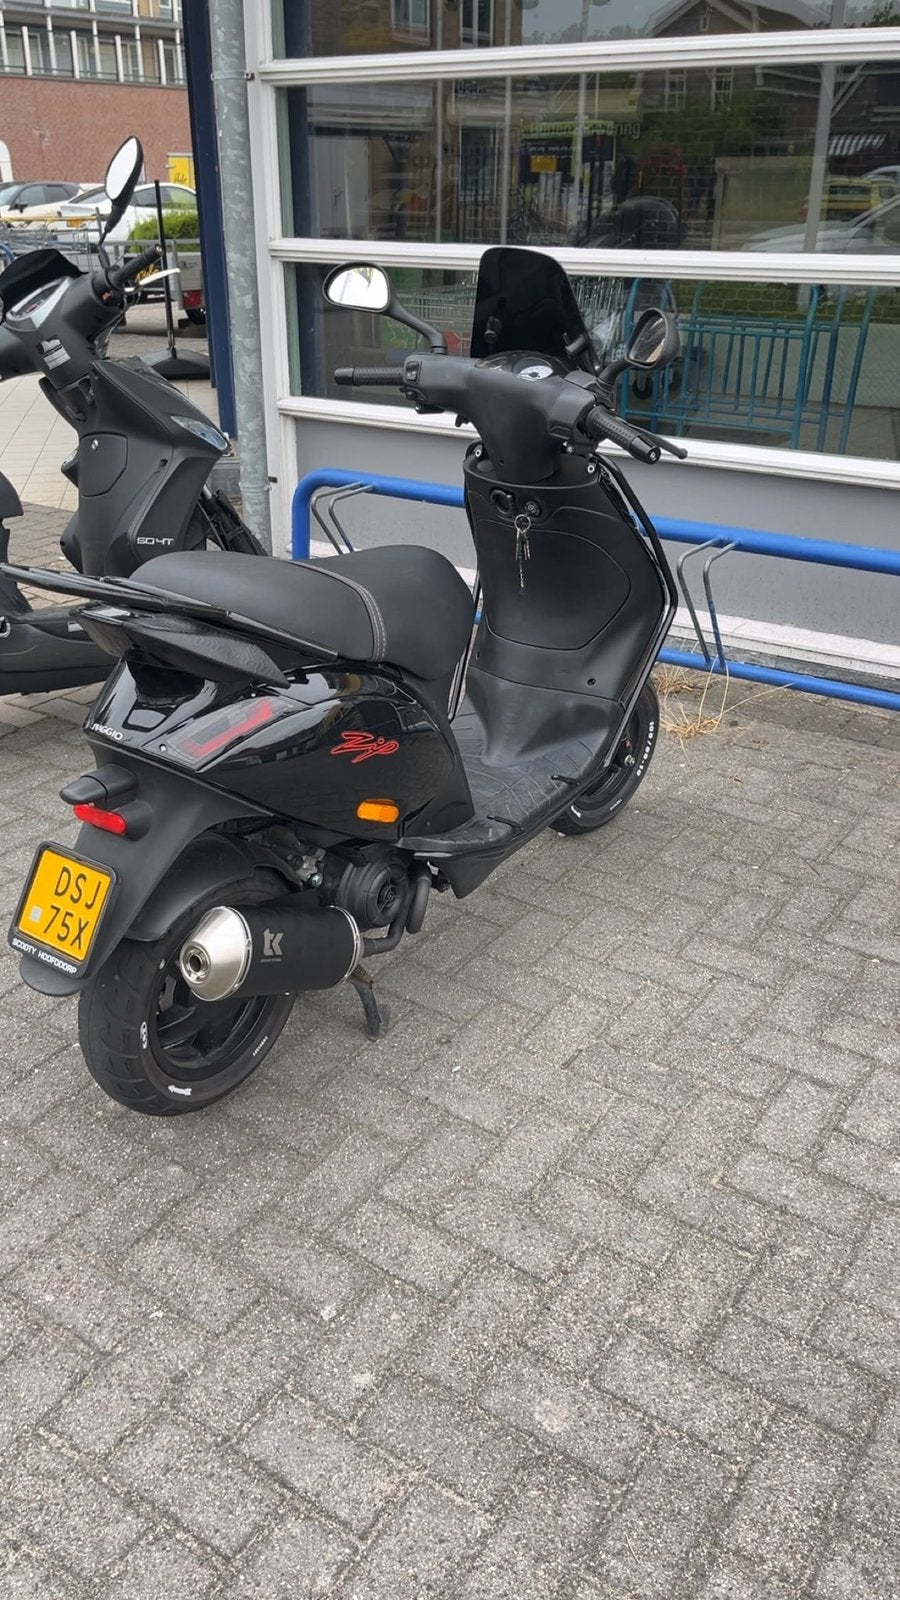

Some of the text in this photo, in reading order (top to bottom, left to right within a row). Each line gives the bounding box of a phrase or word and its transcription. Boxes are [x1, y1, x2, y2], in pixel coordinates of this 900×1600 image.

[91, 723, 123, 741] IAGGIO
[330, 731, 399, 763] Zip
[54, 866, 102, 910] DSJ
[43, 904, 90, 951] 75X
[12, 938, 37, 955] SCOOTY
